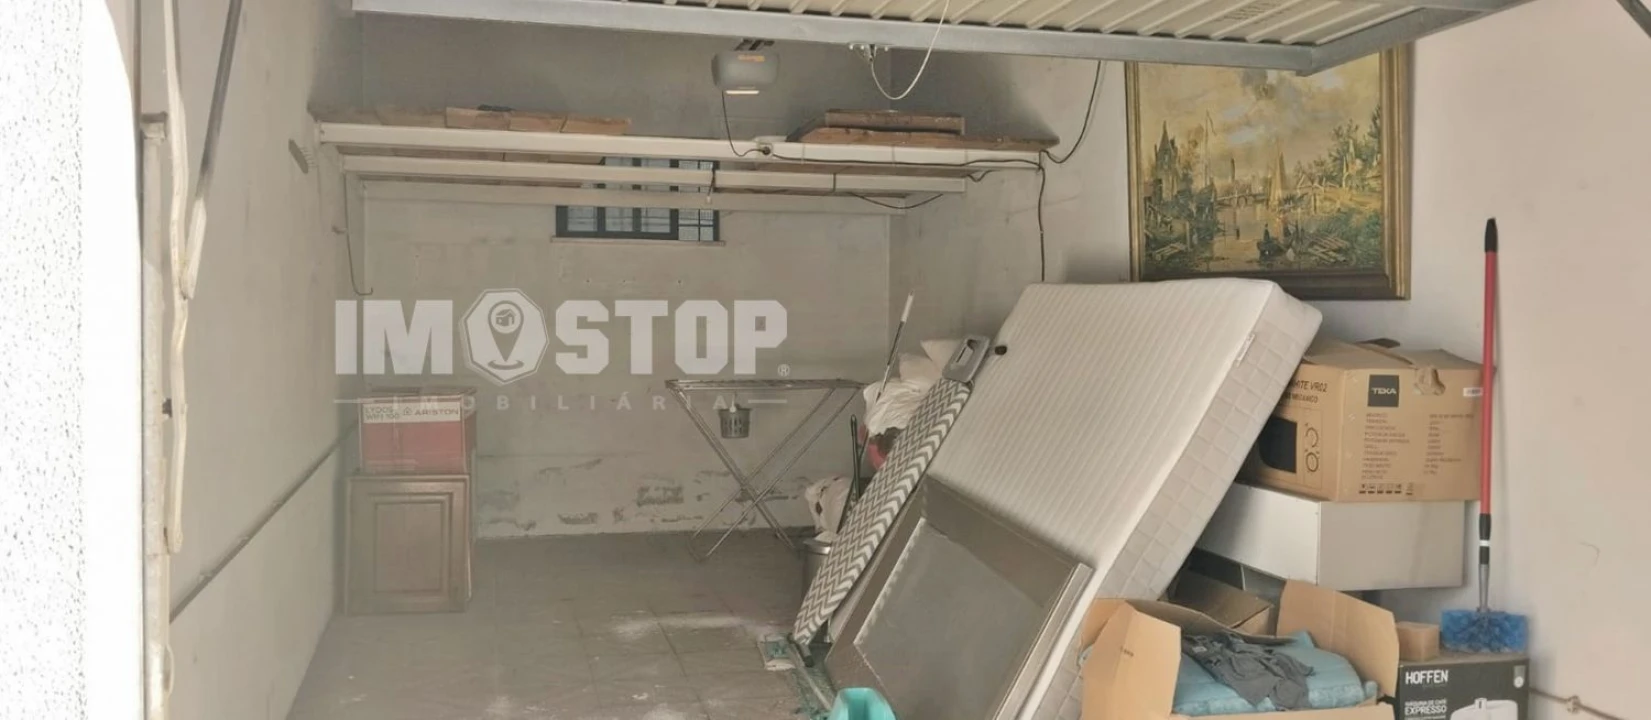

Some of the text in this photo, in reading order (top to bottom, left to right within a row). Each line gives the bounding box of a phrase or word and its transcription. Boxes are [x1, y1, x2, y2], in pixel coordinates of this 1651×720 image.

[1371, 387, 1397, 395] TEKA
[415, 408, 459, 416] ARISTON
[1405, 670, 1449, 684] HOFFEN
[1404, 705, 1447, 715] EXPRESSO
